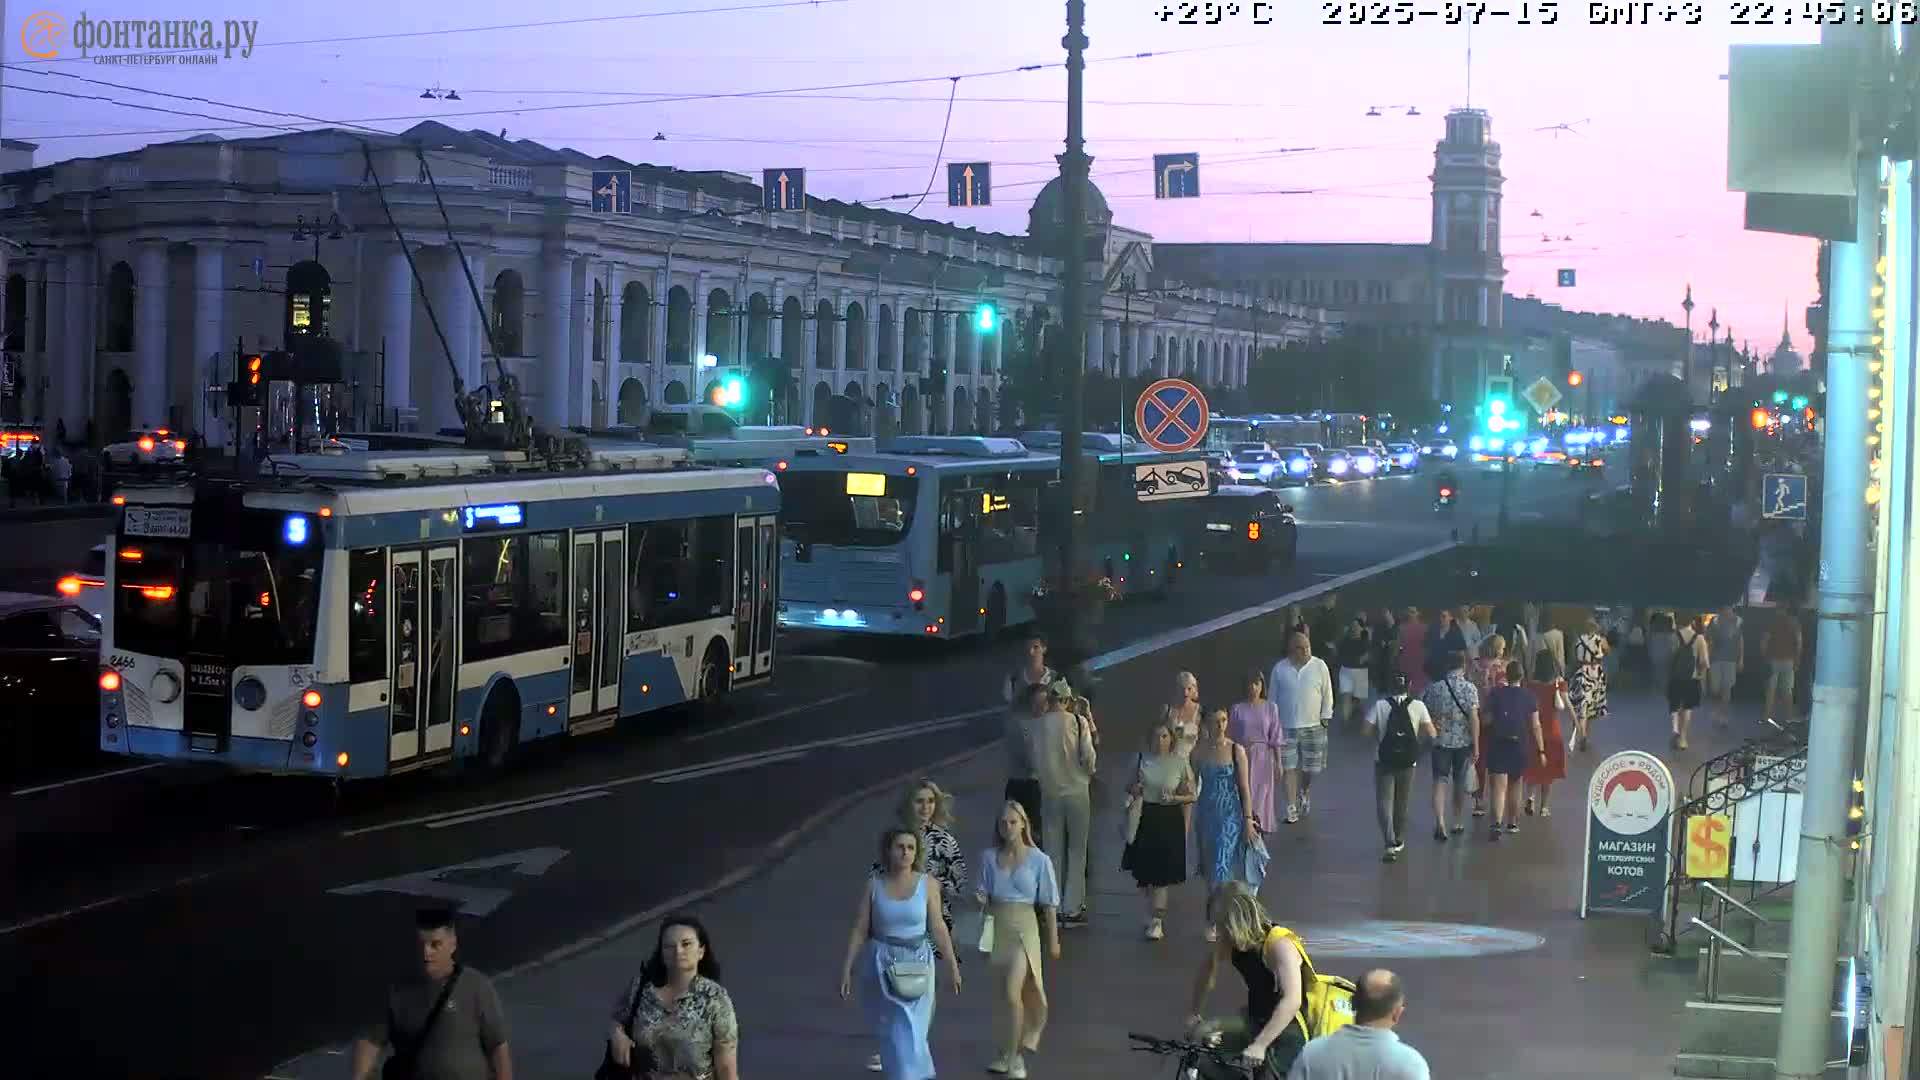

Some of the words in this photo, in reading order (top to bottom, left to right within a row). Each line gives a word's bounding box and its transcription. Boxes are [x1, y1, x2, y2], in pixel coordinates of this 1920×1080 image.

[110, 655, 136, 669] 2466
[1598, 841, 1657, 853] МАГАЗИН
[1597, 854, 1656, 864] ПЕТЕРБУРГСКИХ
[1607, 866, 1644, 877] КОТОВ
